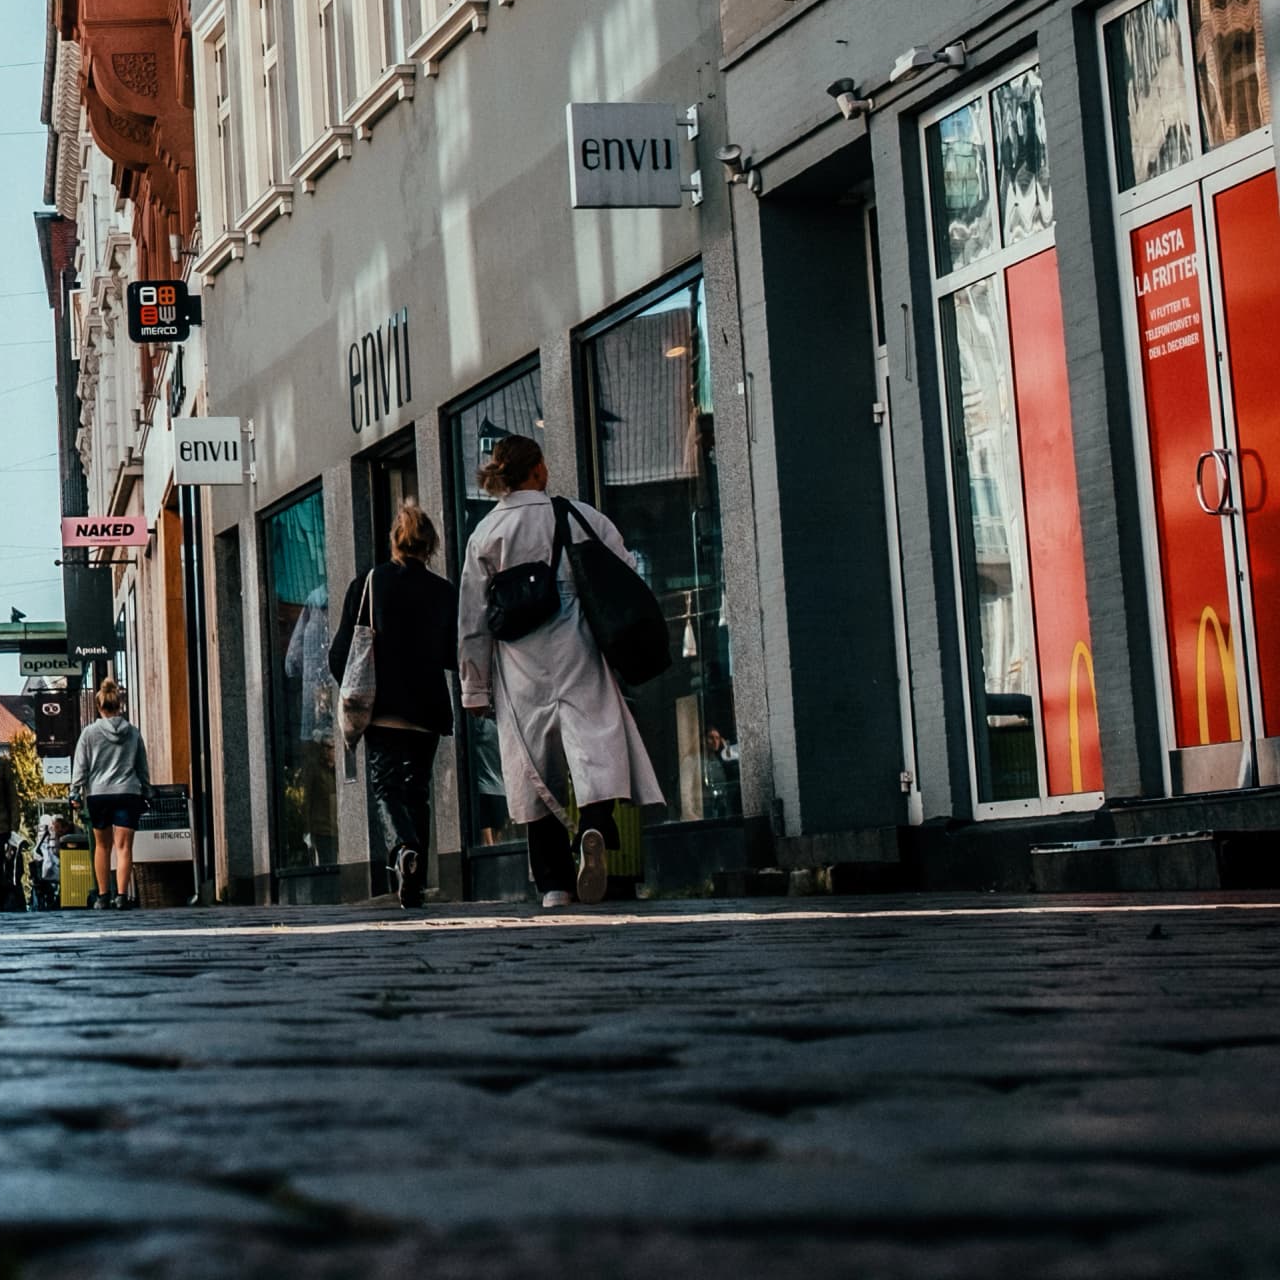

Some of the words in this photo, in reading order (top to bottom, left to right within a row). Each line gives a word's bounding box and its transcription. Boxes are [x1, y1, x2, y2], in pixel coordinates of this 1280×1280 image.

[581, 138, 672, 172] envii
[1145, 228, 1185, 263] HASTA
[1136, 272, 1152, 297] LA
[1152, 253, 1200, 292] FRITTER
[1149, 309, 1157, 321] VI
[1156, 300, 1181, 319] FLYTTER
[1181, 296, 1191, 310] TIL
[141, 326, 178, 336] IMERCO
[1145, 314, 1192, 342] TELEFONTORVET
[1192, 312, 1200, 326] 10
[1148, 346, 1161, 360] DEN
[1167, 332, 1200, 354] DECEMBER
[180, 440, 238, 462] envii
[76, 523, 135, 537] NAKED
[75, 646, 108, 656] Apotek
[23, 659, 79, 672] apotek
[46, 765, 69, 775] COS
